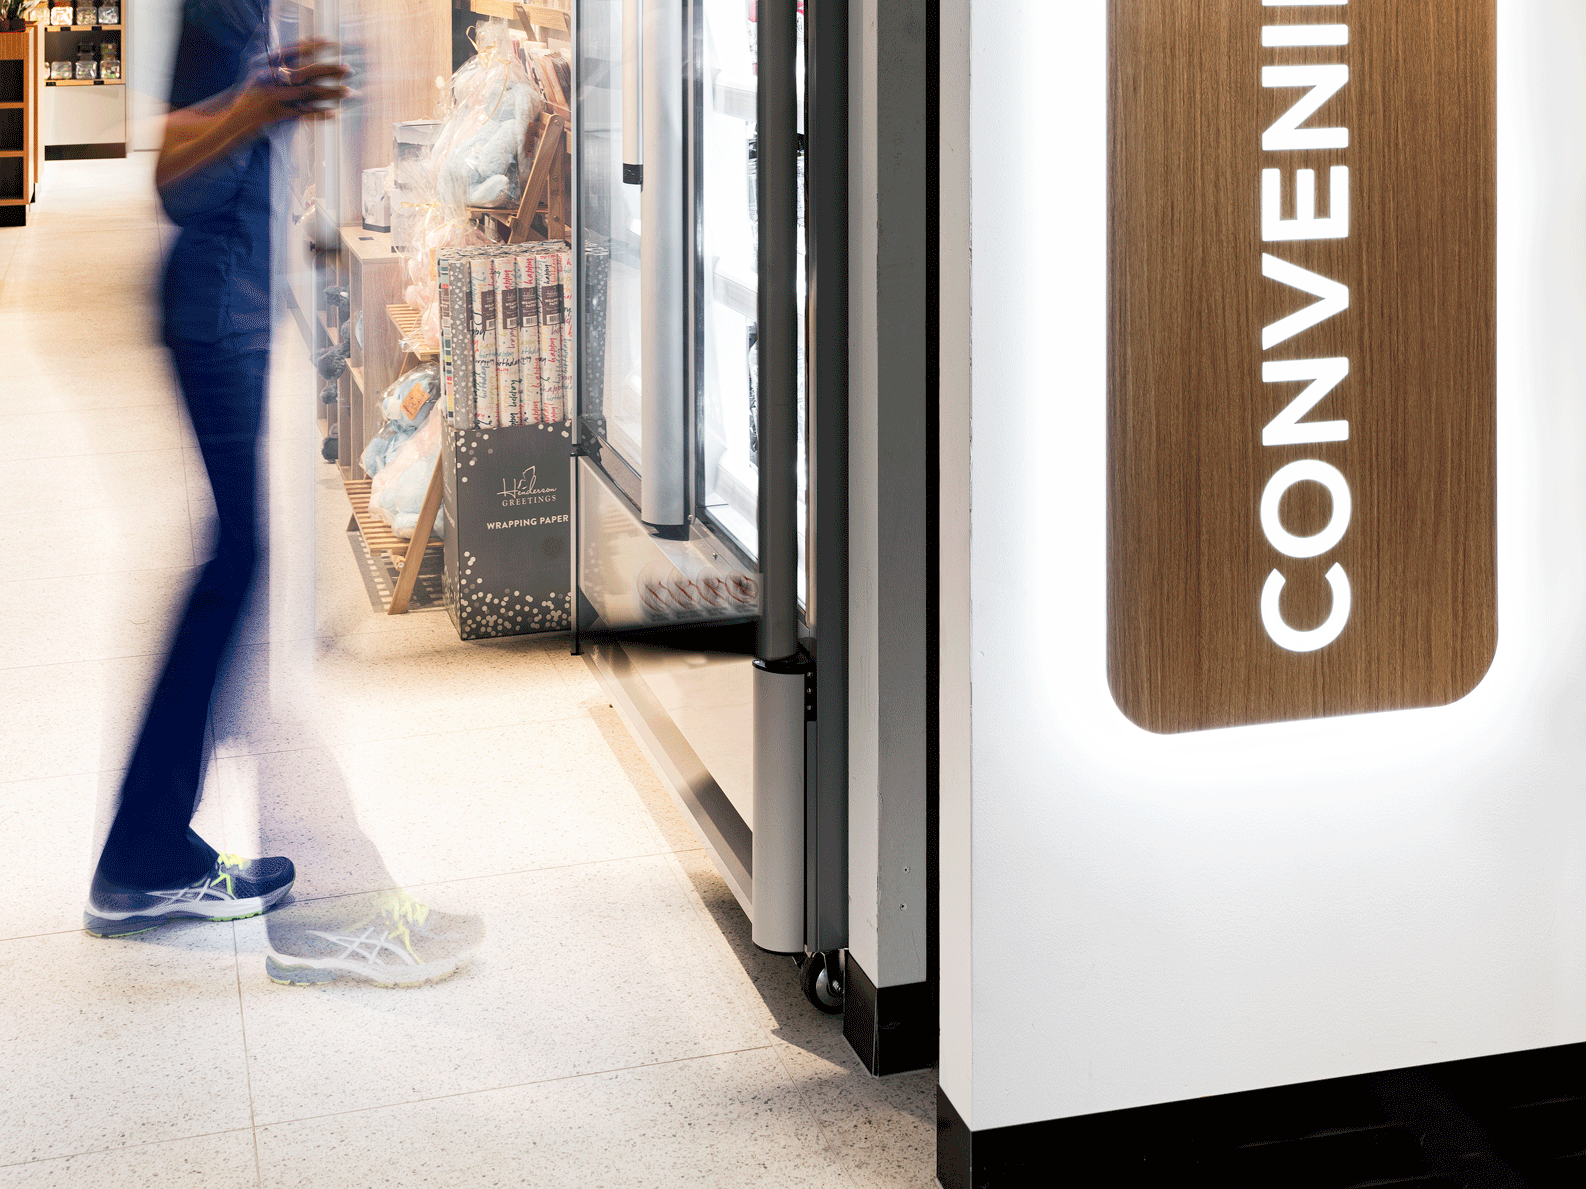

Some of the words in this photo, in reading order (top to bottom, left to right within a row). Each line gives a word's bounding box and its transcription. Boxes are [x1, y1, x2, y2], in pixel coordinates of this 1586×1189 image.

[496, 465, 558, 499] Henderson
[502, 495, 556, 506] GREETINGS
[486, 518, 537, 529] WRAPPING
[540, 514, 569, 525] PAPER
